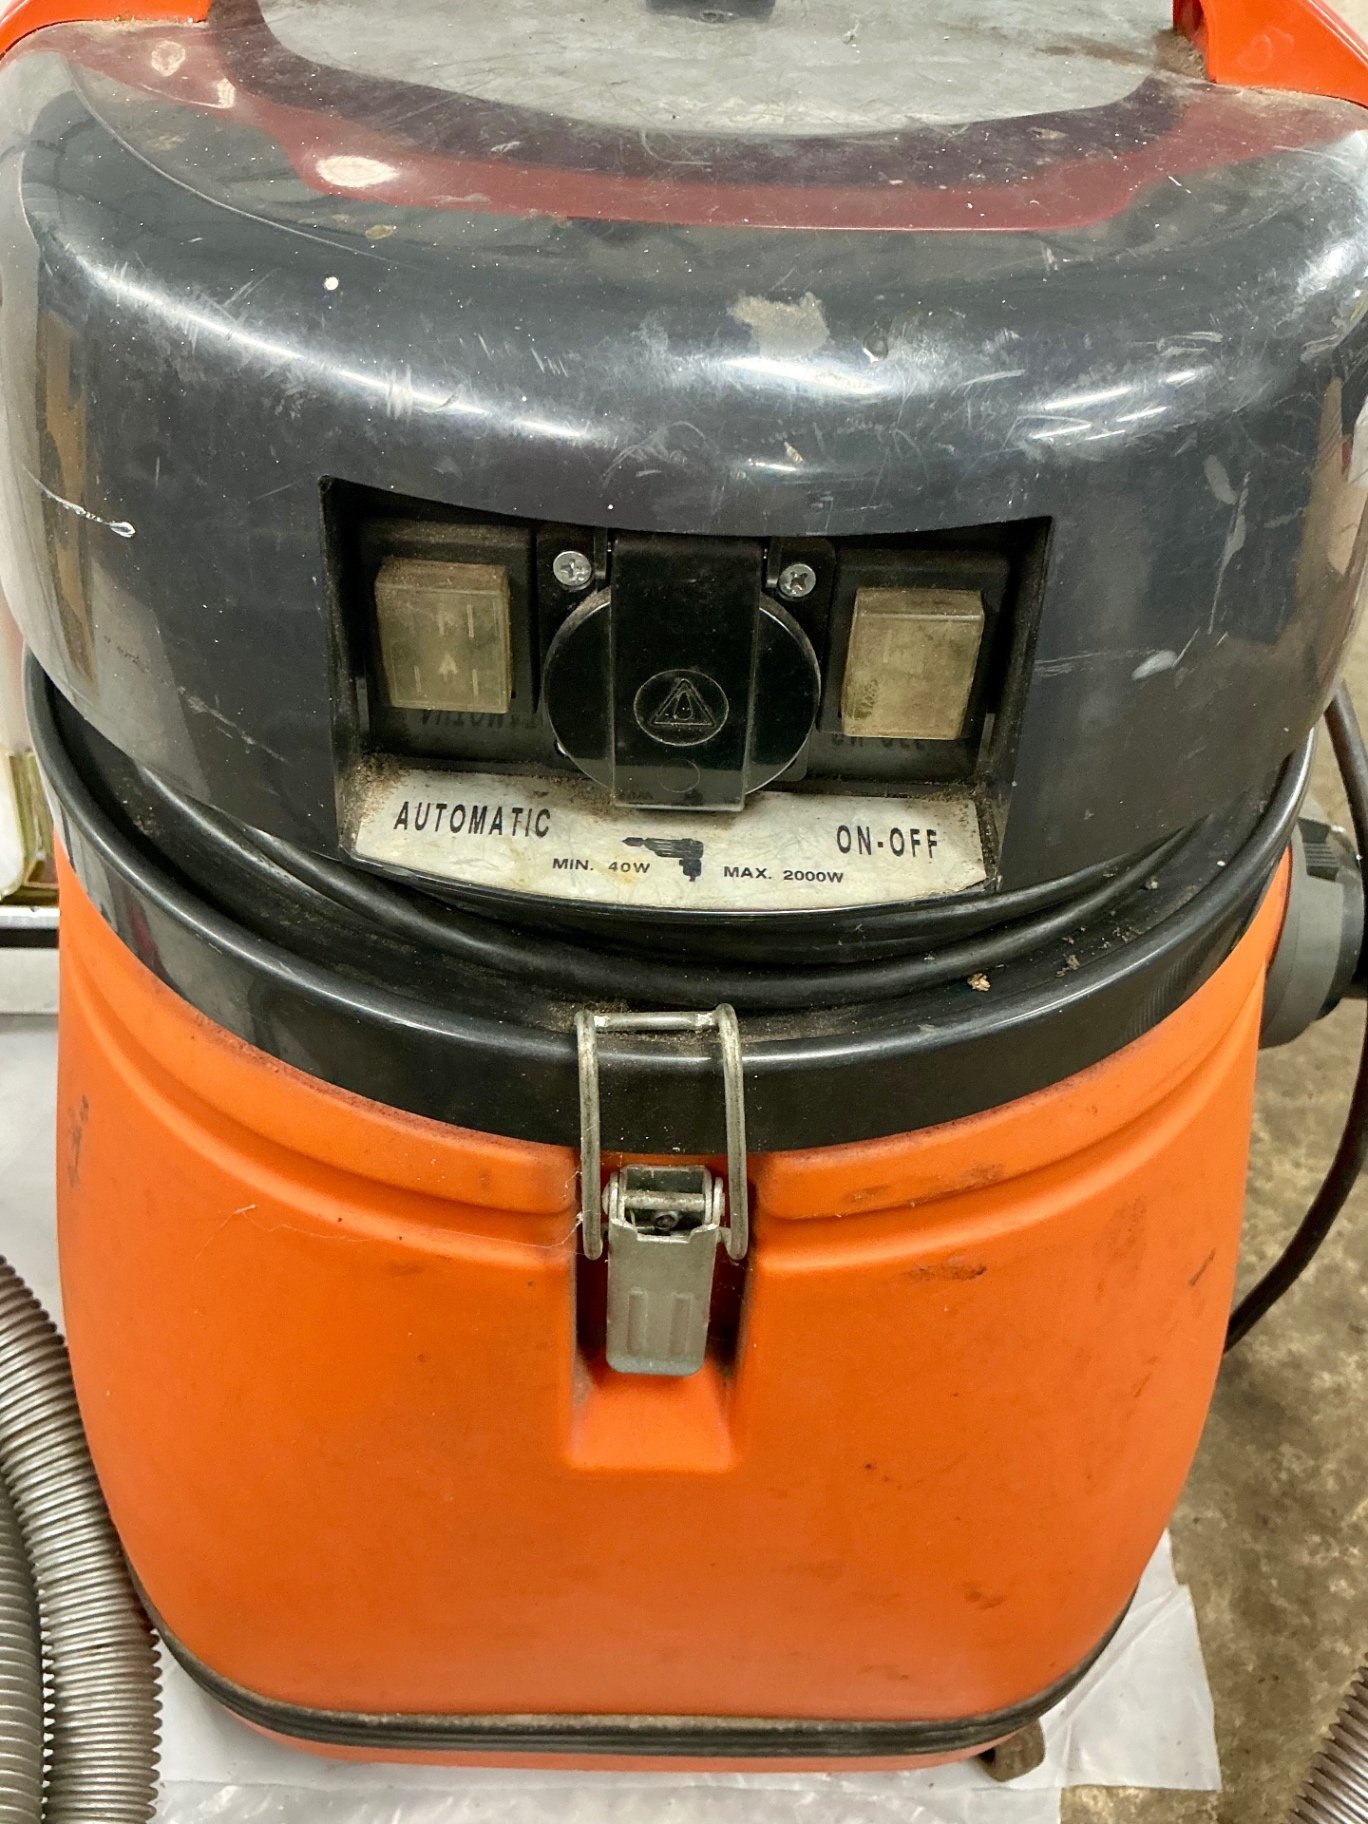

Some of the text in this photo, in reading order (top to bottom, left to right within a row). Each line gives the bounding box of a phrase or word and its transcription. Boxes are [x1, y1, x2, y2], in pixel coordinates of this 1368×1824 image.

[393, 801, 551, 838] AUTOMATIC
[836, 824, 938, 859] ON-OFF
[552, 858, 651, 874] MIN. 40W
[723, 866, 844, 883] MAX. 2000W
